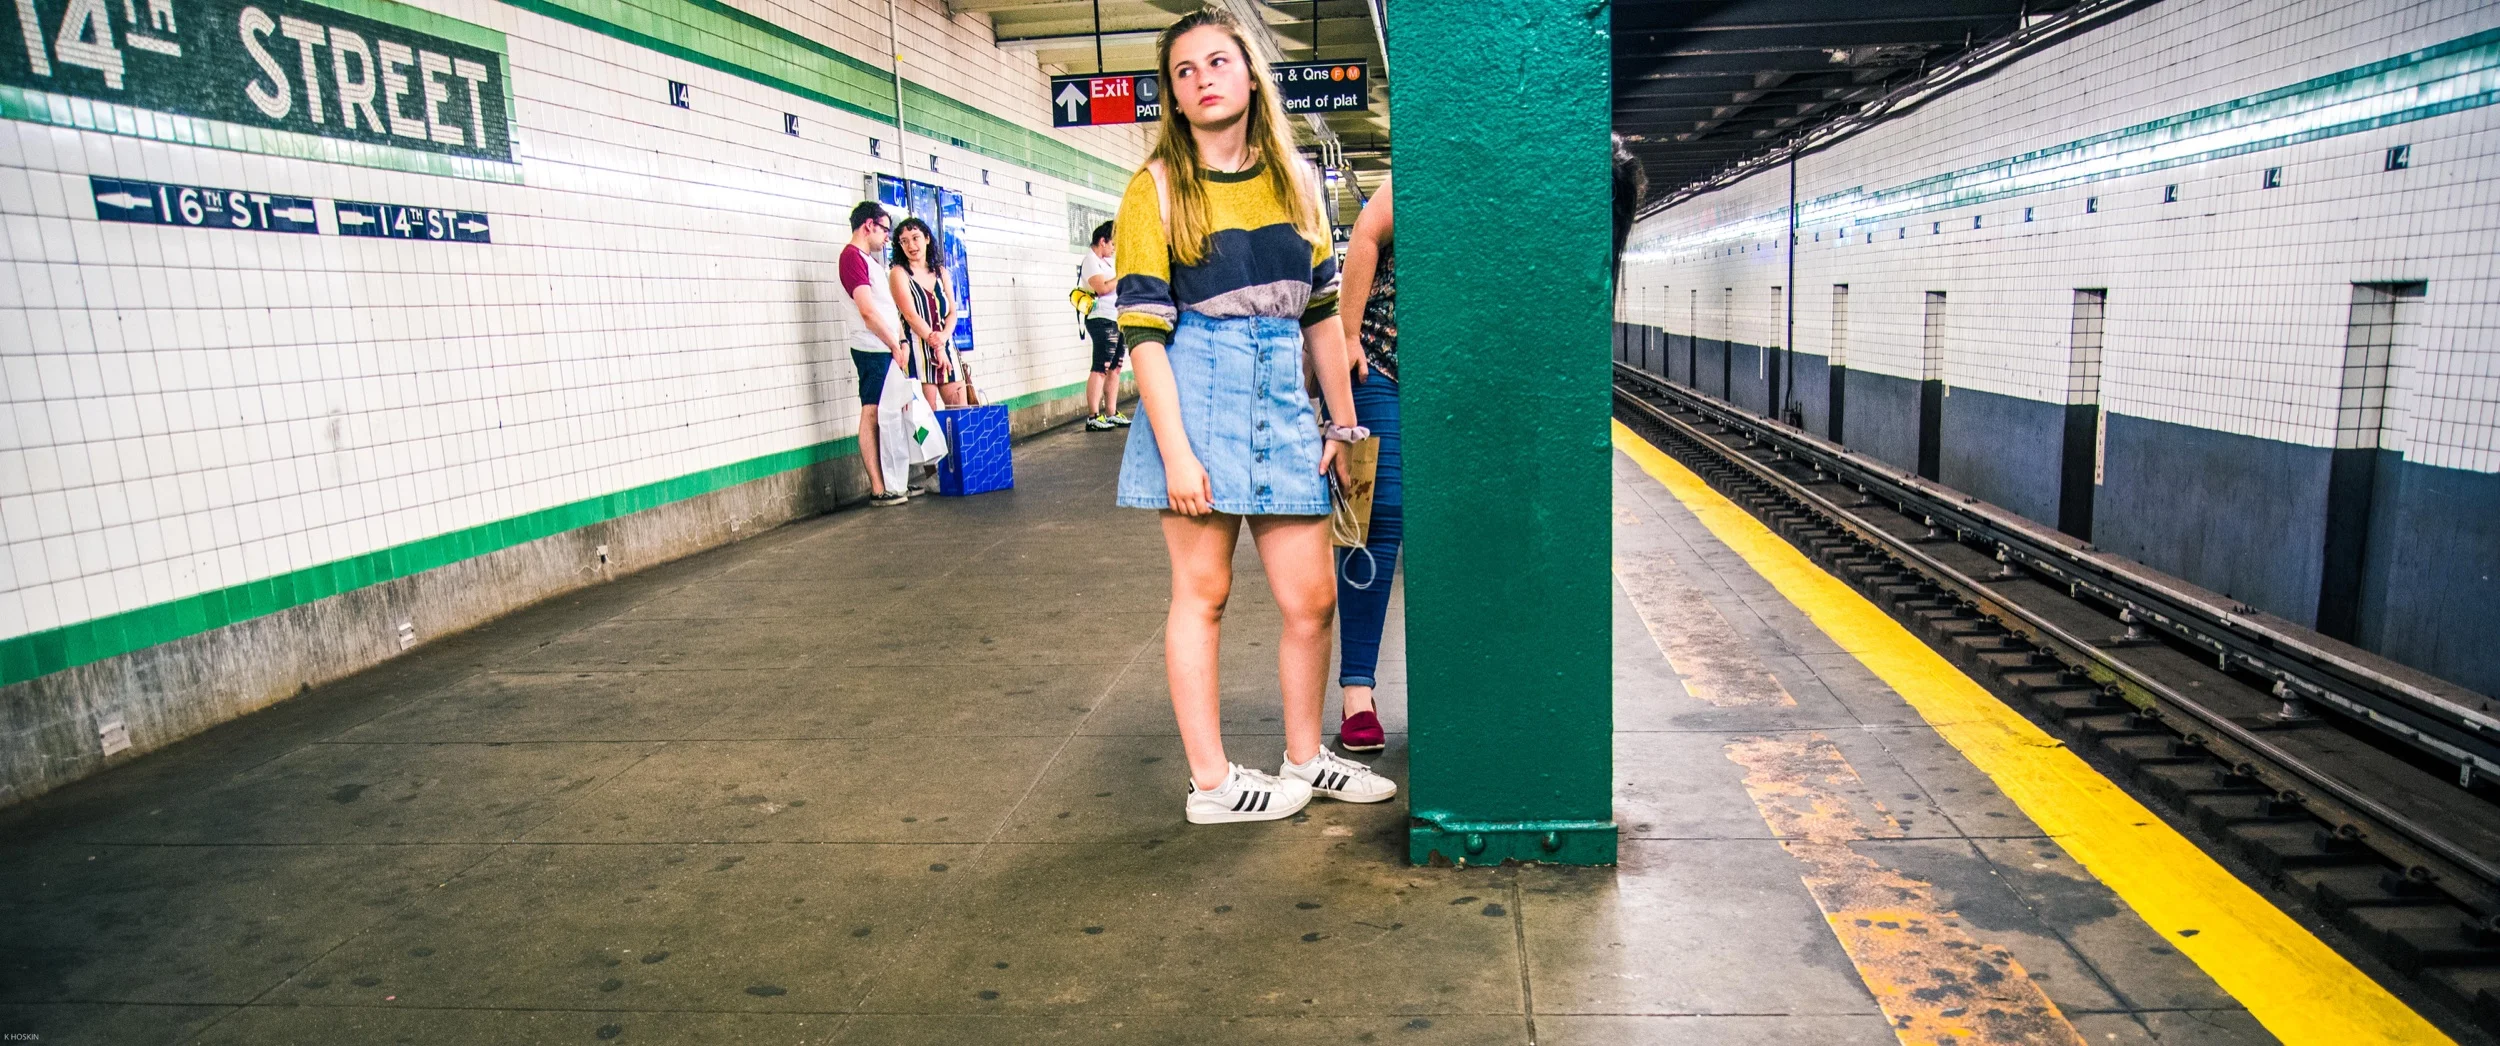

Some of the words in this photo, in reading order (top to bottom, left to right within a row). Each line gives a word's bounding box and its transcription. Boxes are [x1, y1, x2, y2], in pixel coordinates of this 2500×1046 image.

[238, 5, 489, 149] STREET
[1287, 68, 1298, 81] &
[1302, 67, 1329, 81] Qns
[1334, 70, 1341, 78] F
[1348, 69, 1358, 78] M
[670, 79, 690, 108] 14
[1090, 78, 1130, 99] Exit
[1143, 82, 1153, 97] L
[1286, 95, 1311, 109] end
[1315, 95, 1329, 108] of
[1333, 93, 1358, 109] plat
[785, 113, 800, 136] 14
[2387, 146, 2411, 170] 14
[2264, 167, 2282, 188] 14
[2165, 185, 2178, 202] 14
[158, 185, 223, 225] 16TH
[228, 194, 271, 229] ST
[2087, 198, 2098, 213] 14
[379, 204, 424, 238] 14TH
[427, 208, 458, 240] ST
